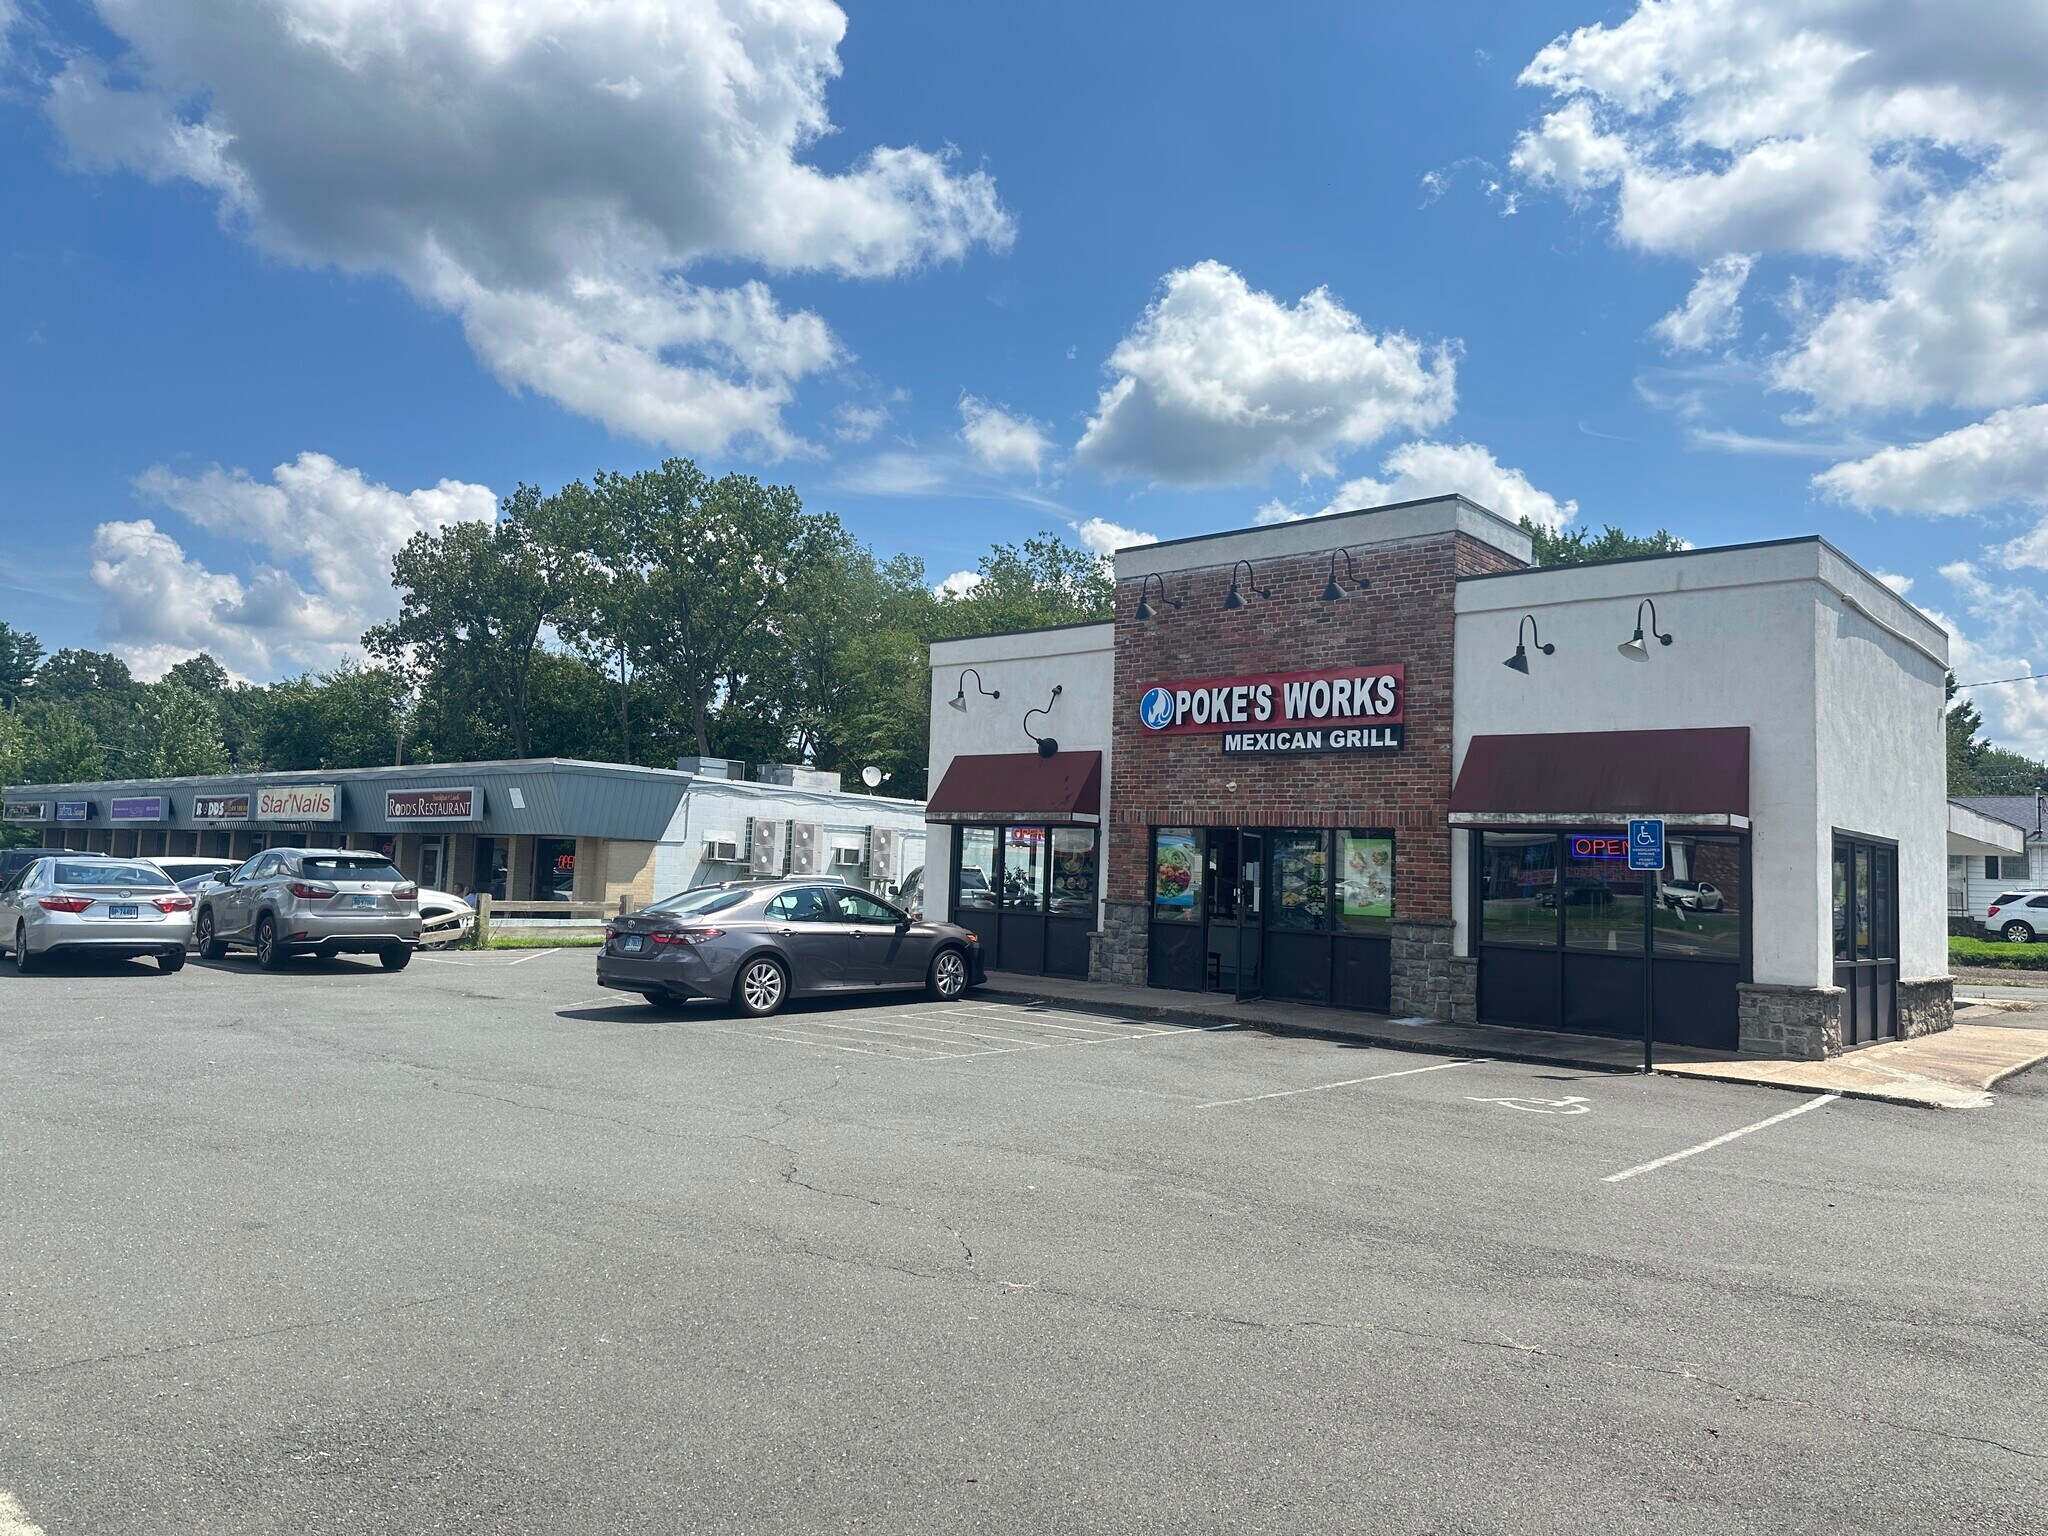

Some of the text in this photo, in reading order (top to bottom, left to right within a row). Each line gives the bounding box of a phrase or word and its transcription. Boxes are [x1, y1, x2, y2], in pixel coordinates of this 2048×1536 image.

[1175, 675, 1396, 725] POKE'S WORKS
[1225, 728, 1398, 751] MEXICAN GRILL
[418, 798, 471, 816] RESTAURANT
[1013, 828, 1046, 840] OPEN
